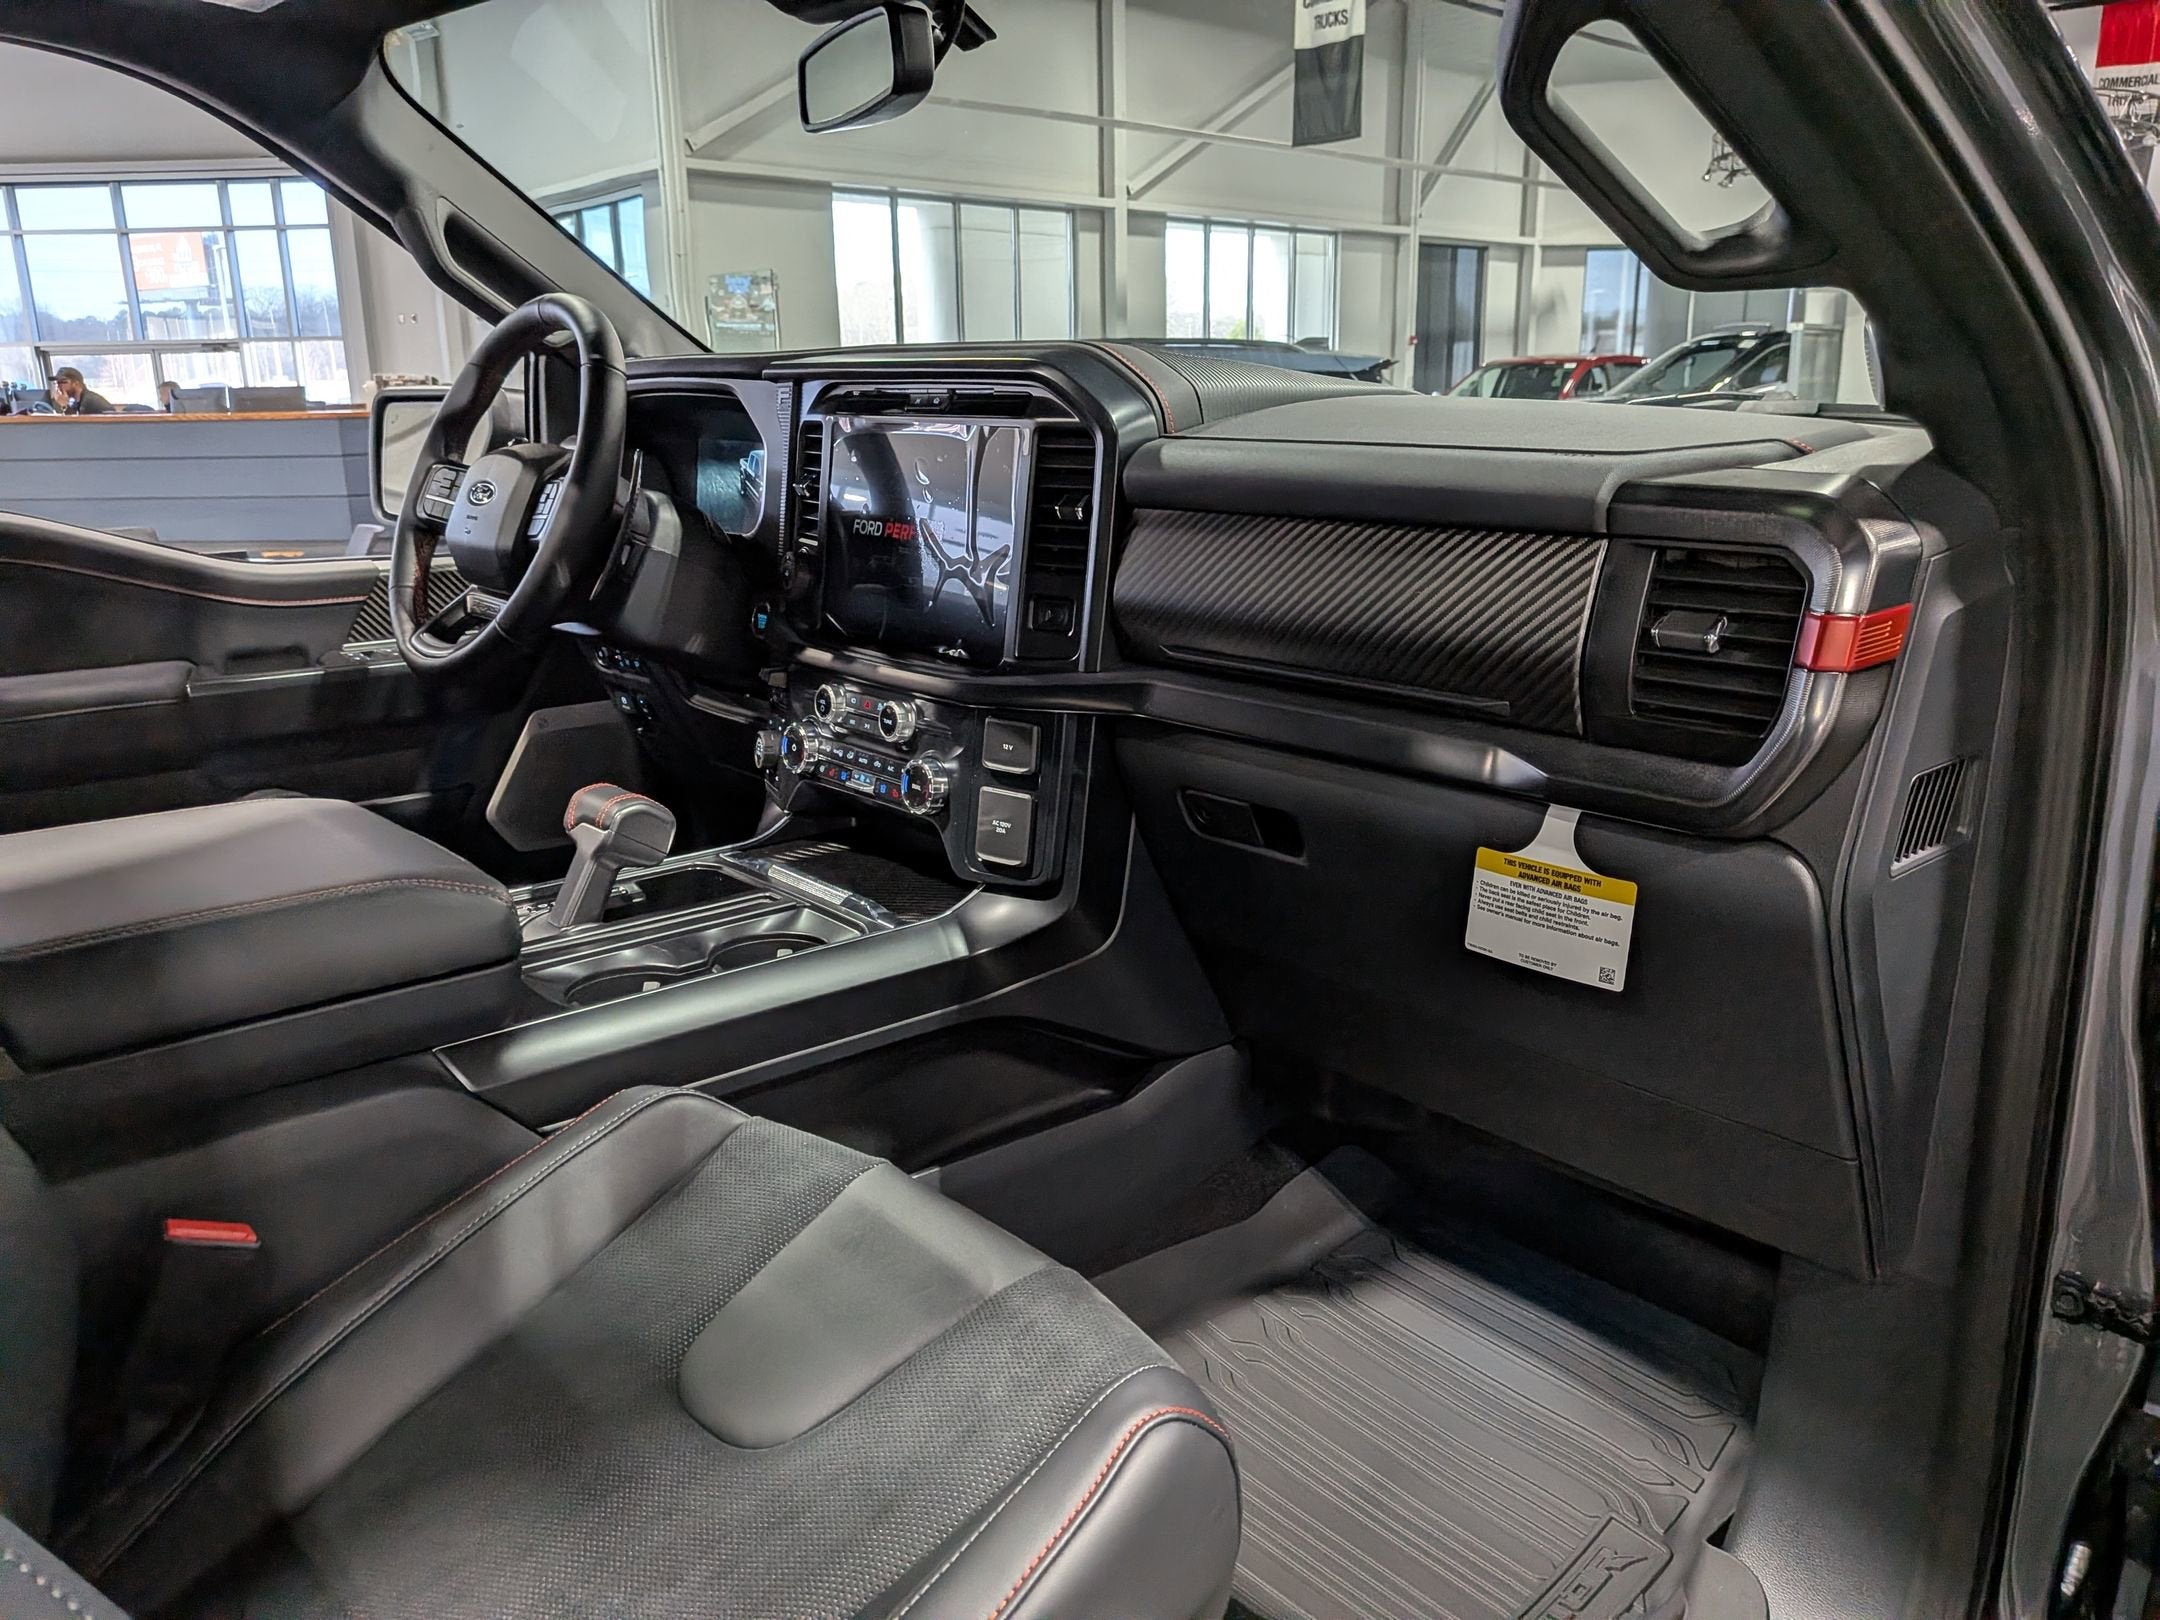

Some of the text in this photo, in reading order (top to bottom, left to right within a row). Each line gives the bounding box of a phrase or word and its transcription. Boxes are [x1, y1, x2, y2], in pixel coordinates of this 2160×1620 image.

[1314, 9, 1348, 30] TRUCKS
[2099, 73, 2159, 89] COMMERCIAL
[853, 519, 883, 536] FORD
[1504, 858, 1602, 888] THIS VEHICLE IS EQUIPPED WITH
[1518, 871, 1581, 892] ADVANCED AIR BAGS
[1480, 880, 1499, 889] Children
[1510, 880, 1522, 888] EVEN
[1523, 884, 1536, 892] WITH
[1536, 888, 1563, 898] ADVANCED
[1574, 896, 1588, 905] BAGS
